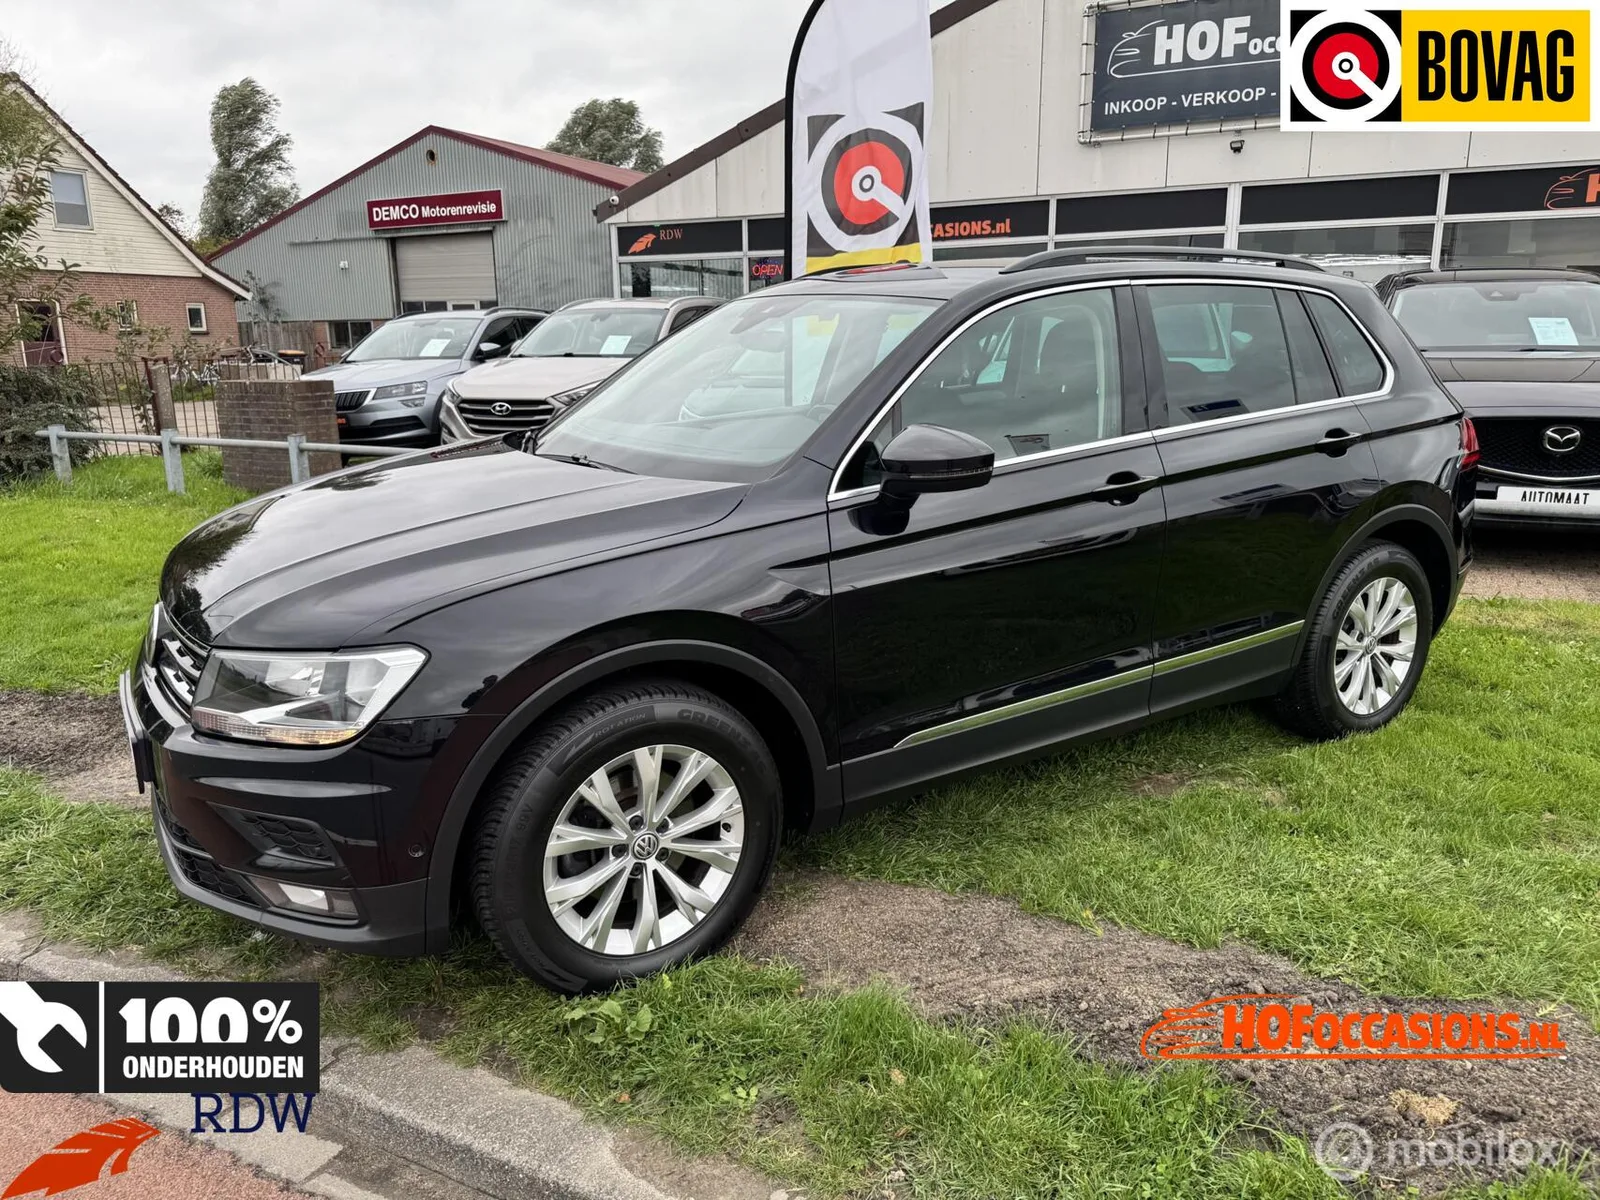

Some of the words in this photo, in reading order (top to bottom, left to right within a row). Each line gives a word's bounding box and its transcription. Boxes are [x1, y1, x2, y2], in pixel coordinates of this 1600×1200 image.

[1104, 96, 1167, 116] INKOOP
[1181, 87, 1266, 108] VERKOOP
[372, 204, 419, 222] DEMCO
[421, 201, 497, 218] Motorenrevisie
[659, 228, 684, 241] RDW
[930, 218, 1011, 238] ASIONS.nl
[752, 263, 784, 277] OPEN
